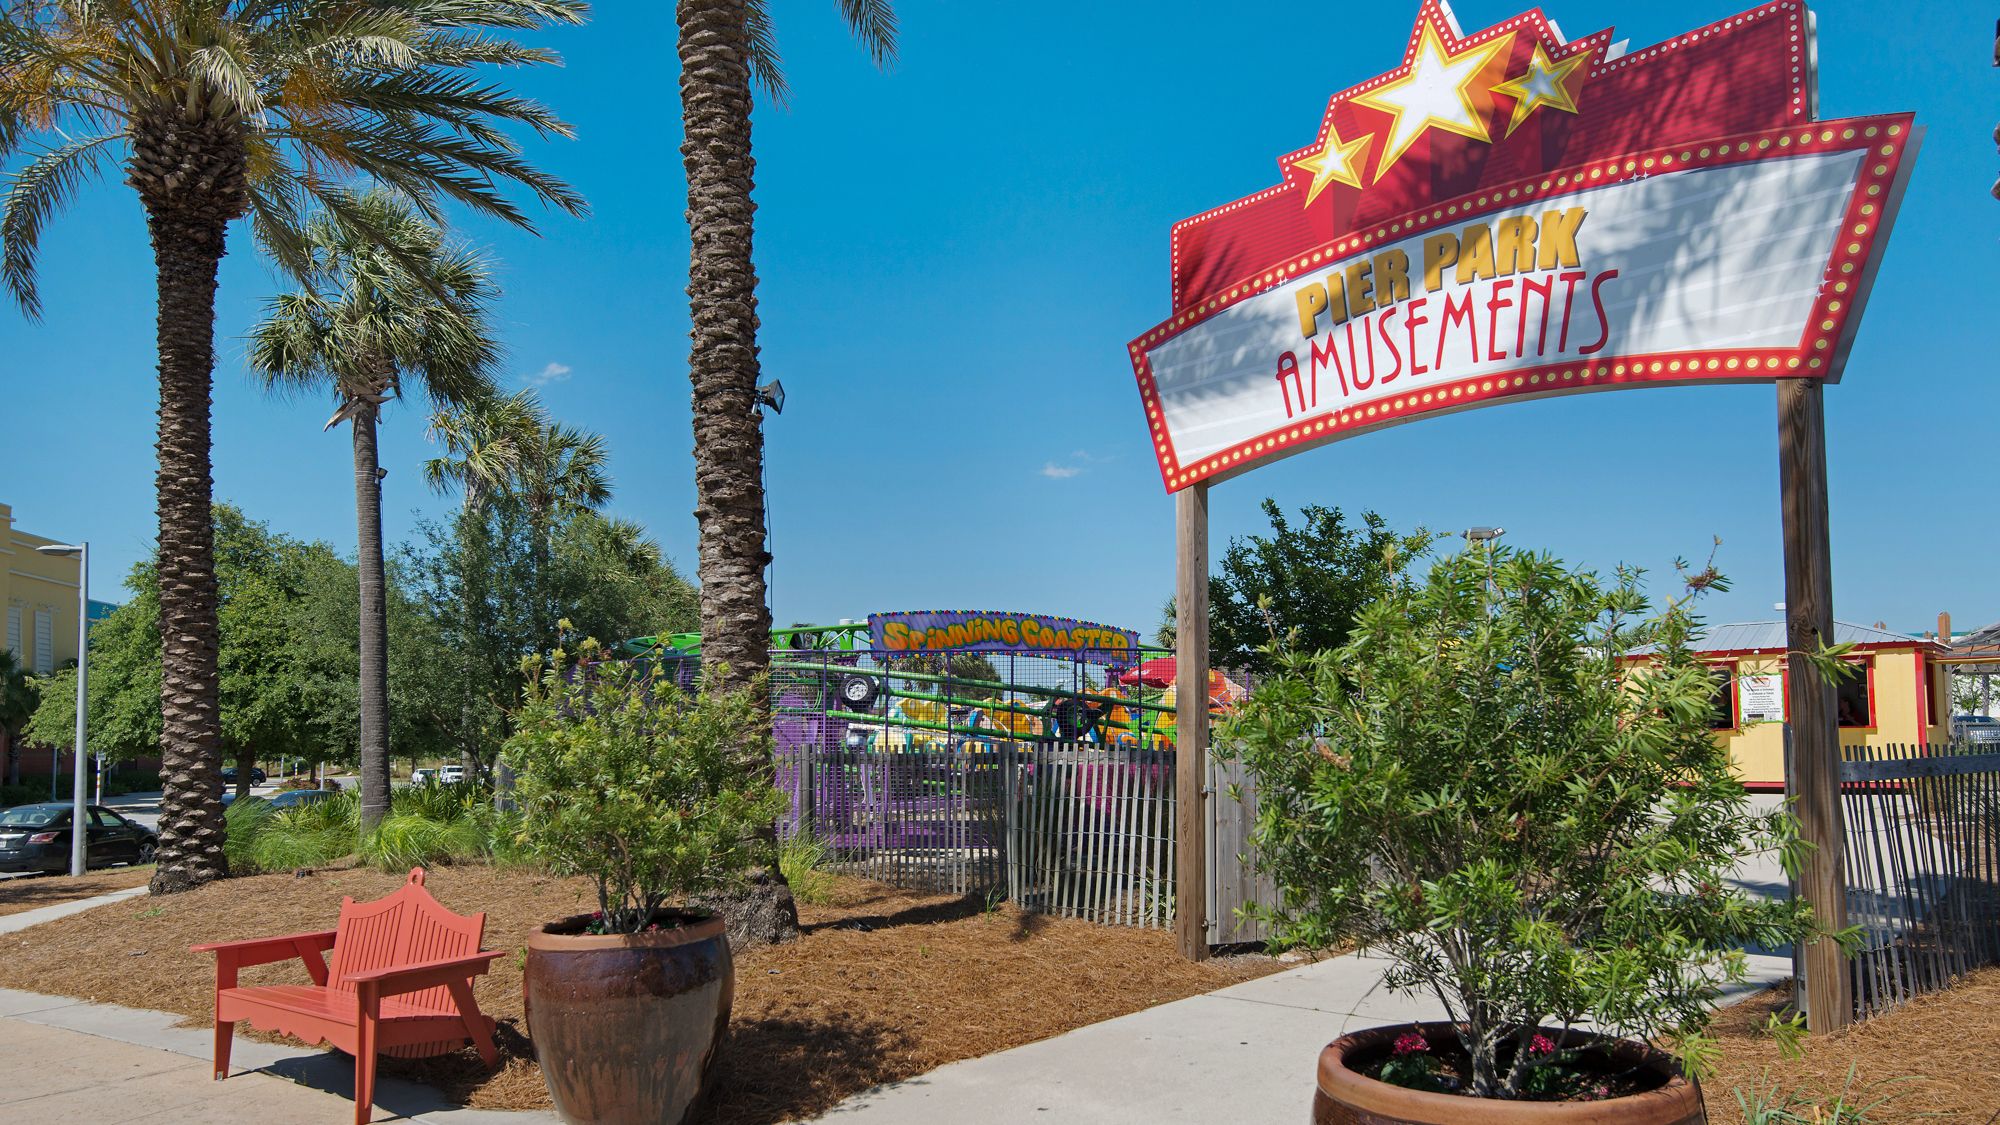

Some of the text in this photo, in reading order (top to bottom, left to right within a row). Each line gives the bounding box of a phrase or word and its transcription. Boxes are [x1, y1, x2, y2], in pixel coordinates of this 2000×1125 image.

[1295, 207, 1588, 339] PIER PARK
[1276, 269, 1619, 418] AMUSEMENTS
[1020, 619, 1130, 661] COASTER
